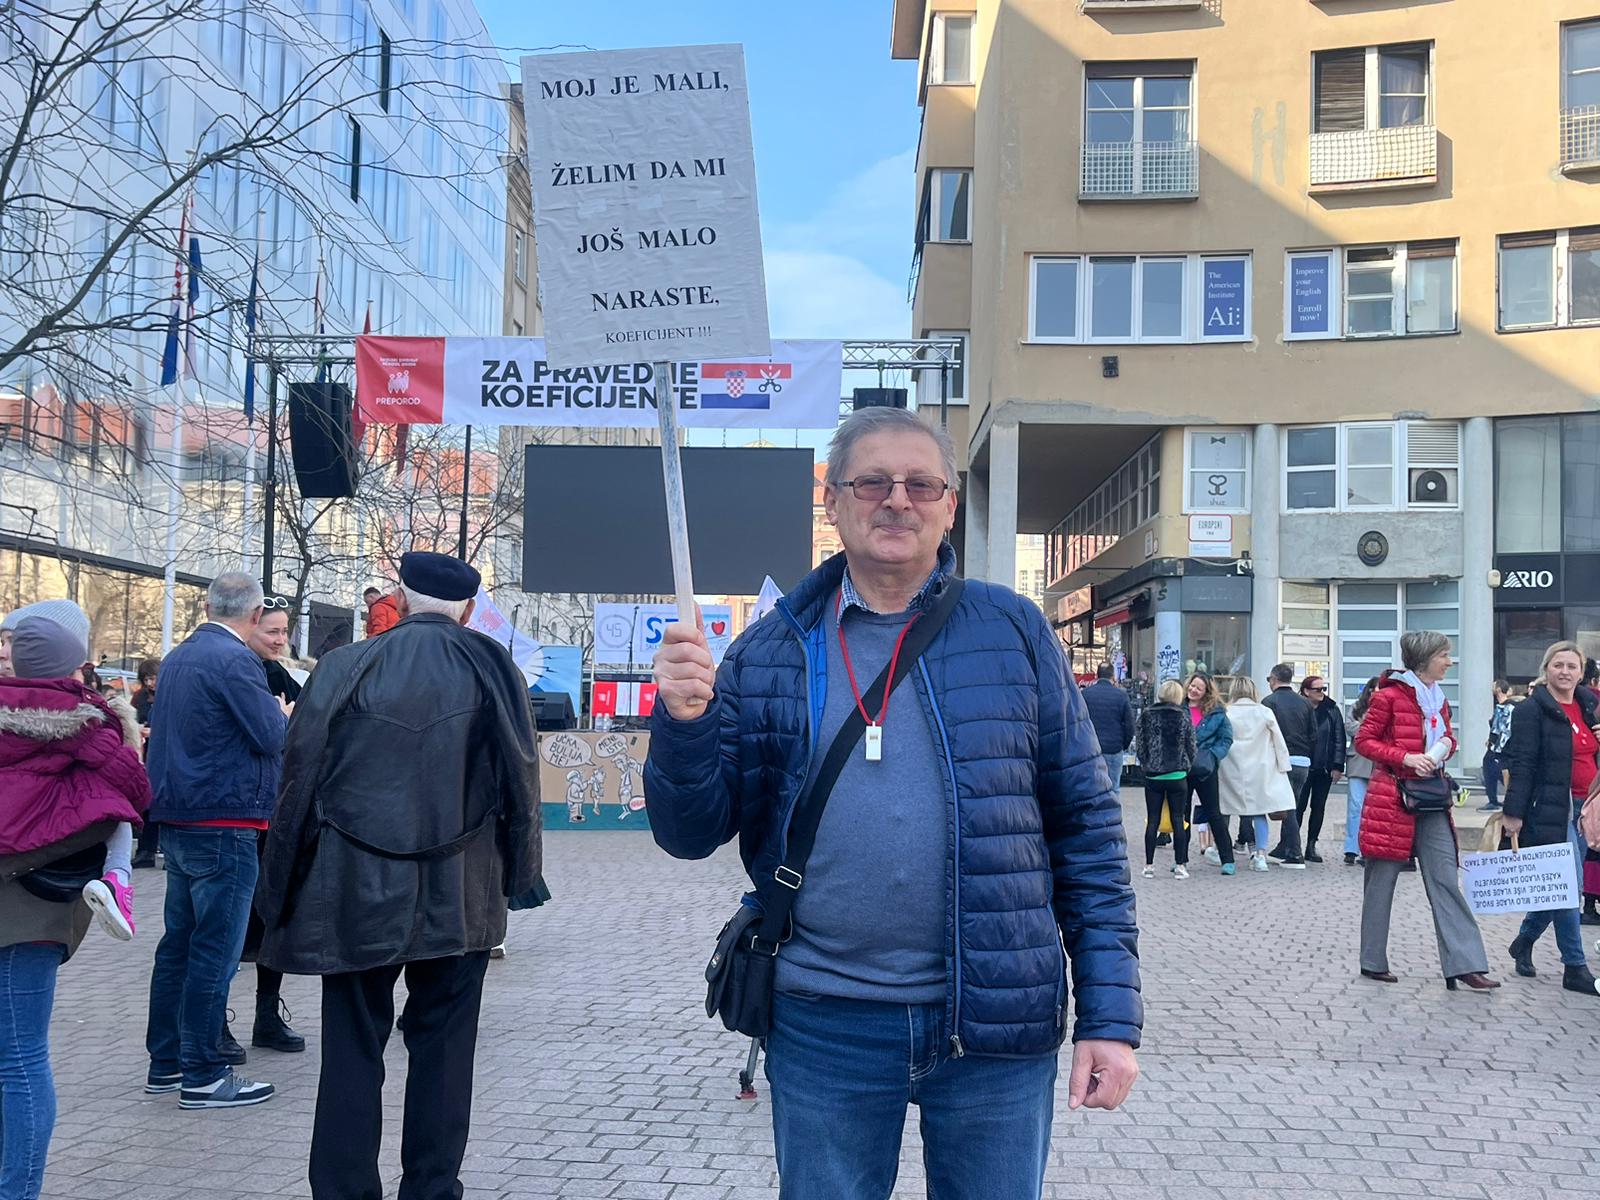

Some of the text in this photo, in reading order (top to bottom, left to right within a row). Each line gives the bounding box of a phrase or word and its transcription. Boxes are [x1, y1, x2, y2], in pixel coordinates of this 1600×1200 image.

[541, 71, 729, 99] MOJ JE MALI,
[551, 157, 726, 187] ŽELIM DA MI
[577, 226, 716, 254] JOŠ MALO
[1208, 271, 1221, 279] The
[1295, 268, 1324, 276] Improve
[1295, 279, 1311, 287] your
[1208, 291, 1236, 299] Institute
[1295, 288, 1322, 297] English
[591, 285, 720, 312] NARASTE,
[1297, 304, 1322, 312] Enroll
[1300, 312, 1320, 321] now!
[605, 326, 712, 344] KOEFICIJENT !!!
[482, 360, 698, 385] ZA PRAVEDIE
[375, 397, 421, 405] PREPOROD
[481, 384, 698, 410] KOEFICIJENE
[606, 622, 622, 638] 45
[1464, 859, 1480, 868] TAKO
[1510, 876, 1519, 884] DA
[1519, 874, 1540, 883] VLADO
[1547, 883, 1569, 892] MANJE
[1492, 888, 1512, 897] VLADE
[1515, 897, 1531, 905] MILO
[1551, 894, 1568, 903] MILO
[1495, 899, 1515, 908] VLADE
